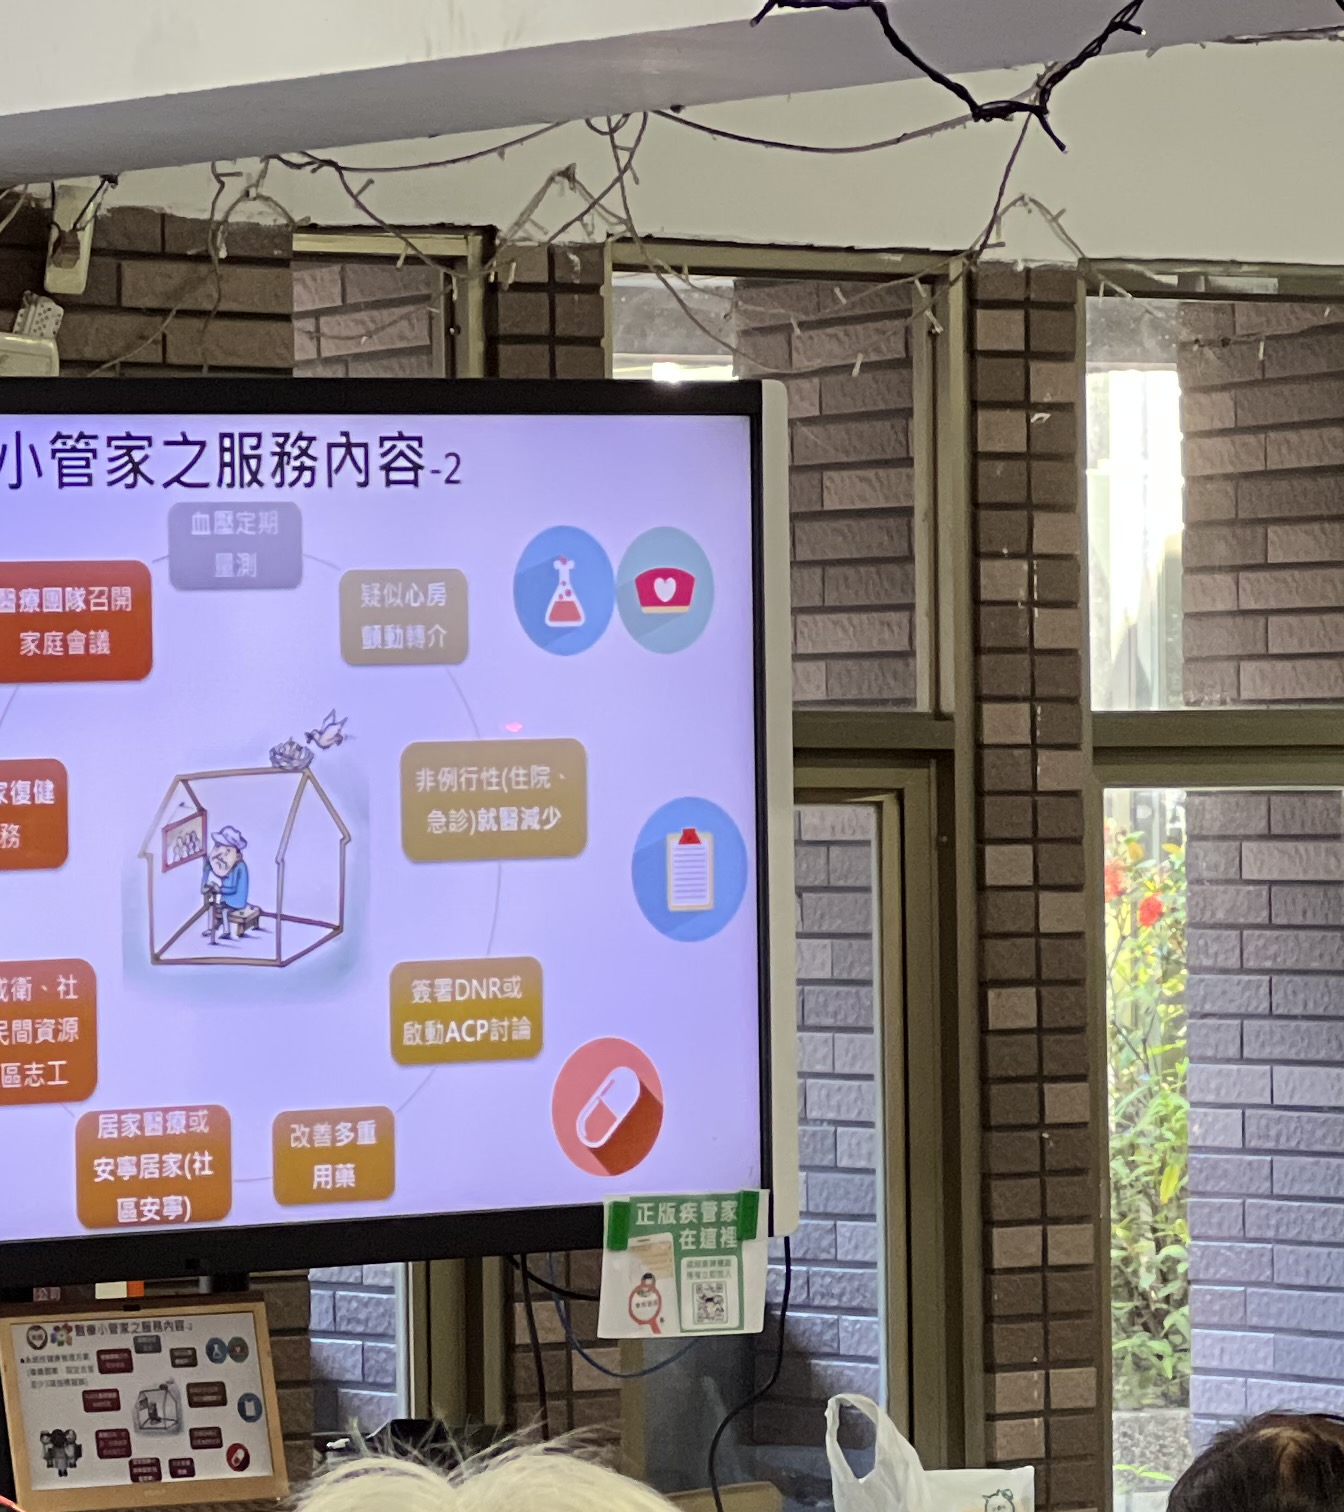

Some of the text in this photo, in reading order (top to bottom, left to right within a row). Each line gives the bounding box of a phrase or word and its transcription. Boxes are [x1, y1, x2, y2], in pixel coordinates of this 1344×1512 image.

[213, 551, 257, 579] 量測
[360, 580, 448, 609] 疑似心房
[19, 629, 111, 657] 家庭會議
[425, 806, 562, 837] 急診)就醫減少
[410, 975, 524, 1005] 簽署DNR或
[97, 1110, 210, 1140] 居家醫療或
[289, 1121, 379, 1149] 改善多重
[93, 1152, 214, 1182] 安寧居家(社
[311, 1162, 357, 1190] 用藥
[116, 1195, 193, 1224] 區安寧)
[634, 1200, 739, 1226] 正版疾管家
